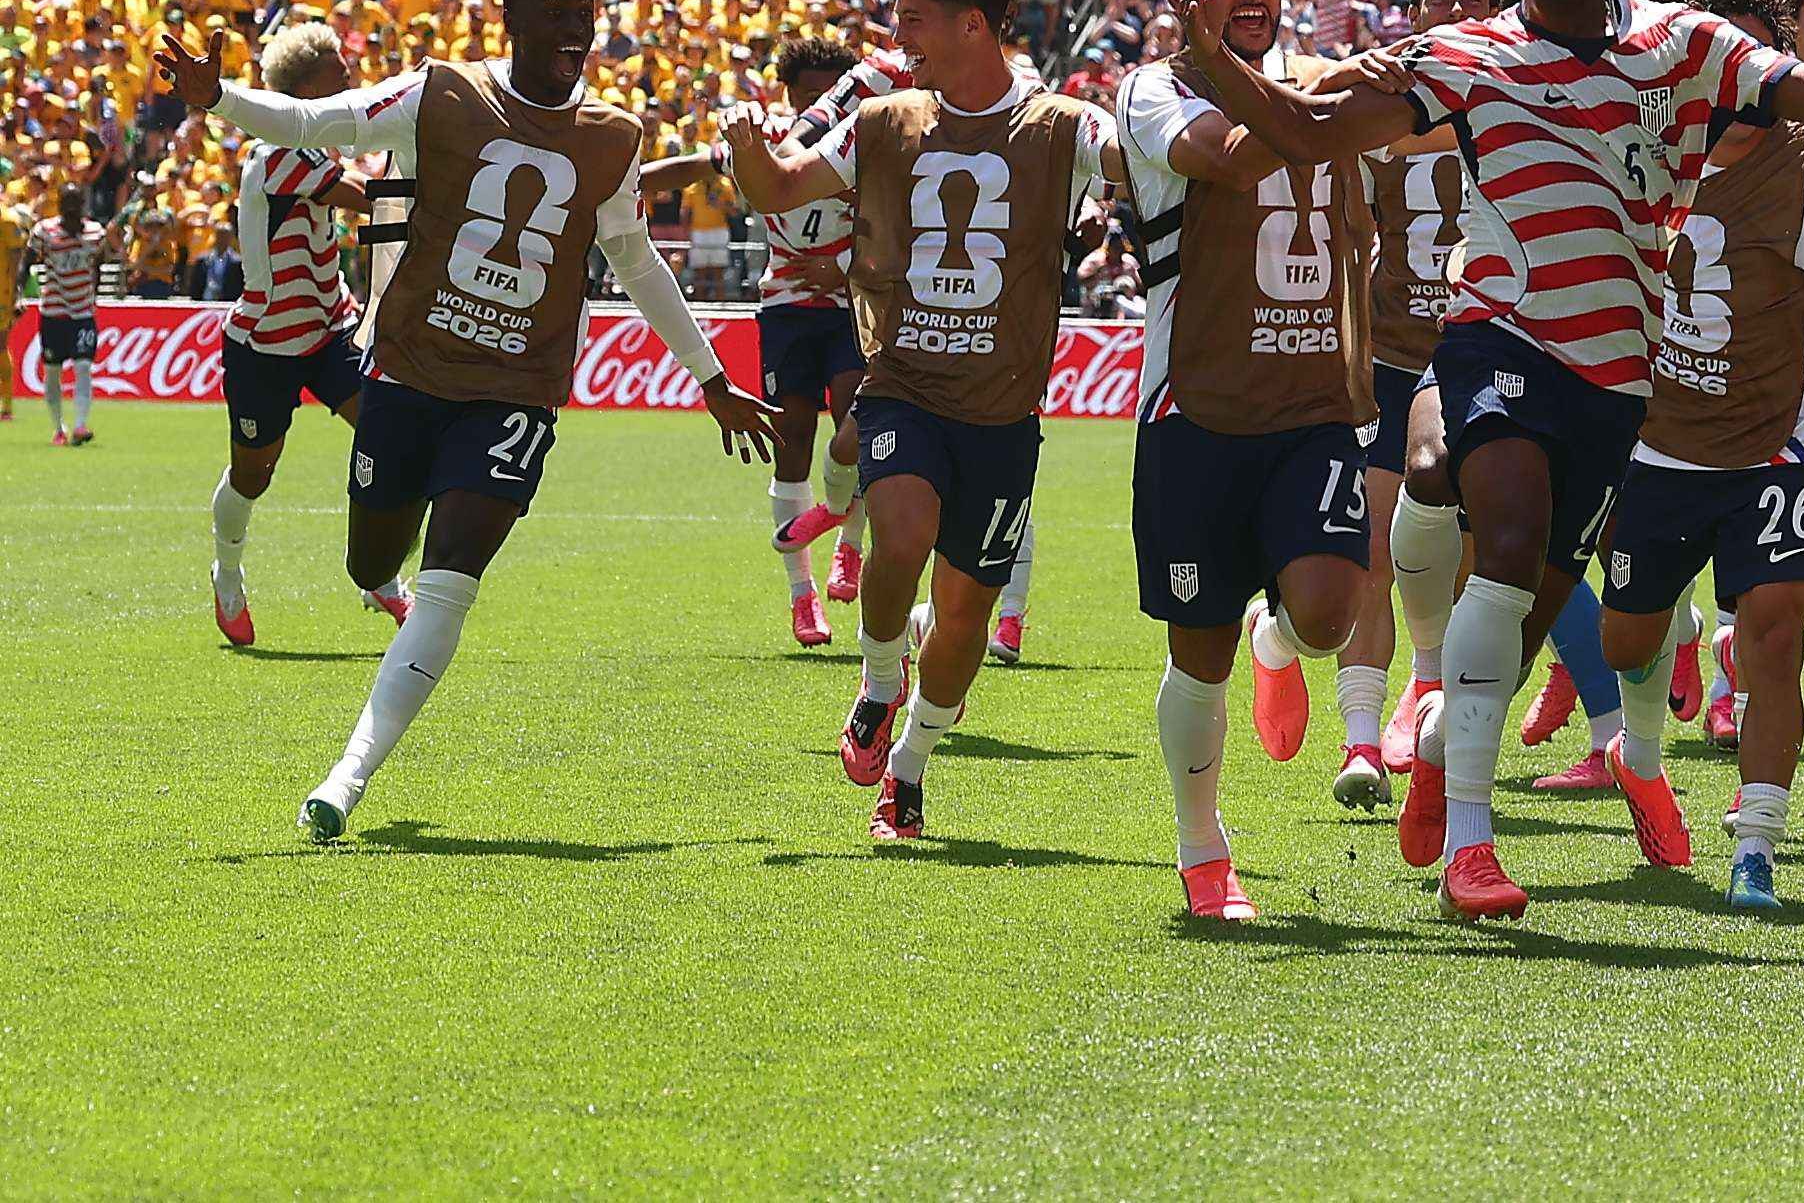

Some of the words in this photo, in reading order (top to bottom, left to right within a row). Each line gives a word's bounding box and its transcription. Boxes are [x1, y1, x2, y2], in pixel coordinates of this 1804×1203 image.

[801, 208, 823, 244] 4
[474, 265, 519, 294] FIFA
[931, 275, 977, 295] FIFA
[1285, 264, 1321, 284] FIFA
[435, 289, 498, 322] WORLD
[498, 311, 533, 331] CUP
[901, 307, 963, 330] WORLD
[964, 314, 999, 330] CUP
[1253, 307, 1311, 326] WORLD
[1313, 306, 1335, 324] CUP
[426, 305, 529, 355] 2026
[895, 326, 996, 355] 2026
[1250, 326, 1340, 356] 2026
[1669, 317, 1702, 338] FIFA
[1658, 342, 1692, 367] ORLD
[1694, 357, 1731, 374] CUP
[1654, 355, 1727, 396] 026
[487, 411, 548, 471] 21
[981, 496, 1031, 551] 14
